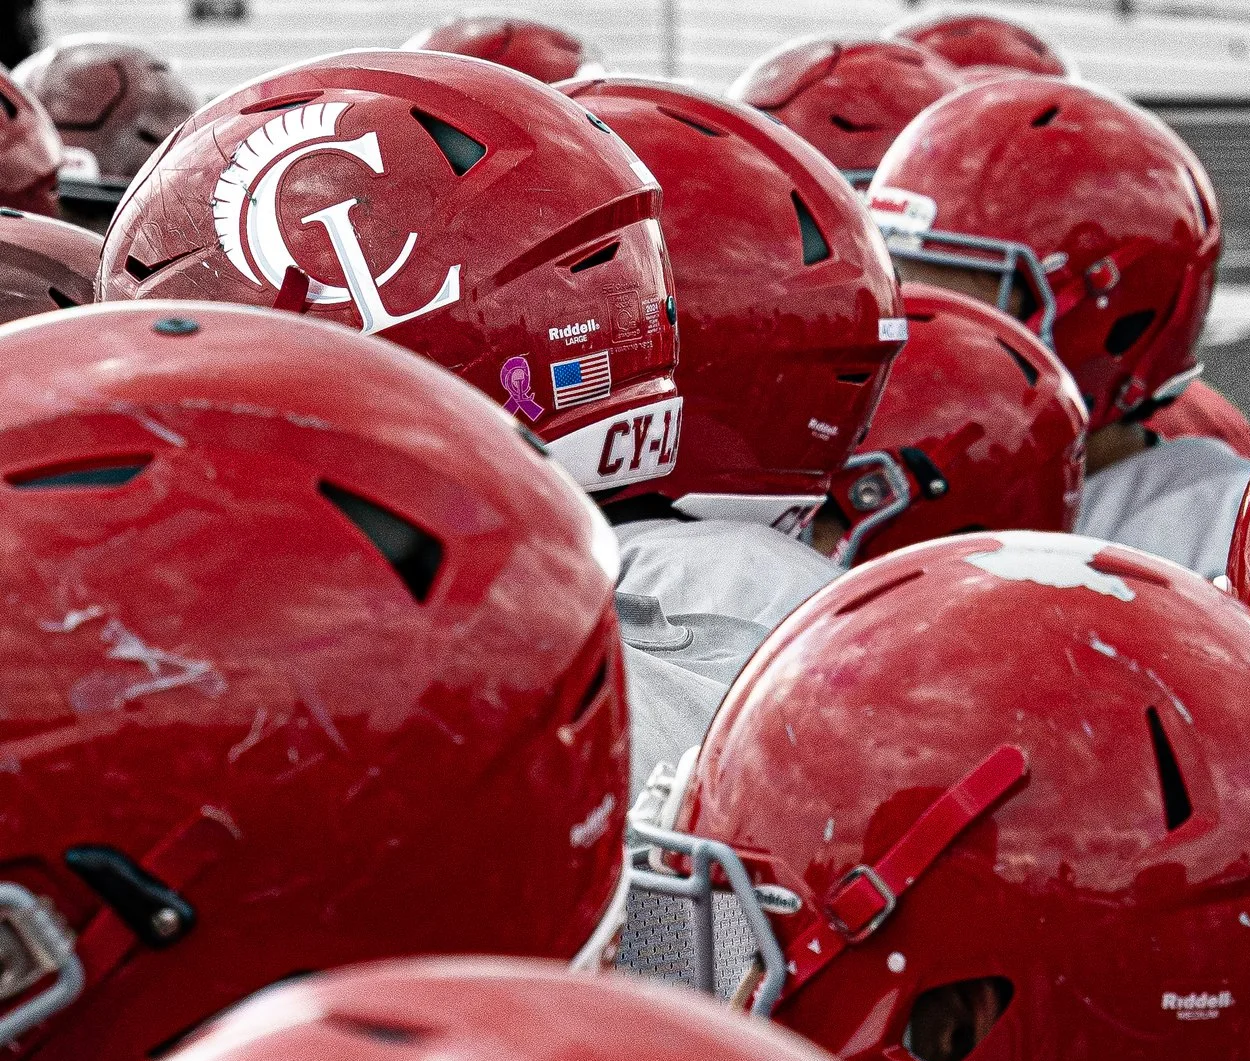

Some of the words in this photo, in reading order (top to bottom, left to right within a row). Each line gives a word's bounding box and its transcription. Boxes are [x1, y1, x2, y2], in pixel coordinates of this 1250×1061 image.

[548, 319, 595, 341] Riddell
[565, 334, 588, 346] LARGE
[597, 405, 684, 478] CY-L
[1161, 990, 1236, 1010] Riddell
